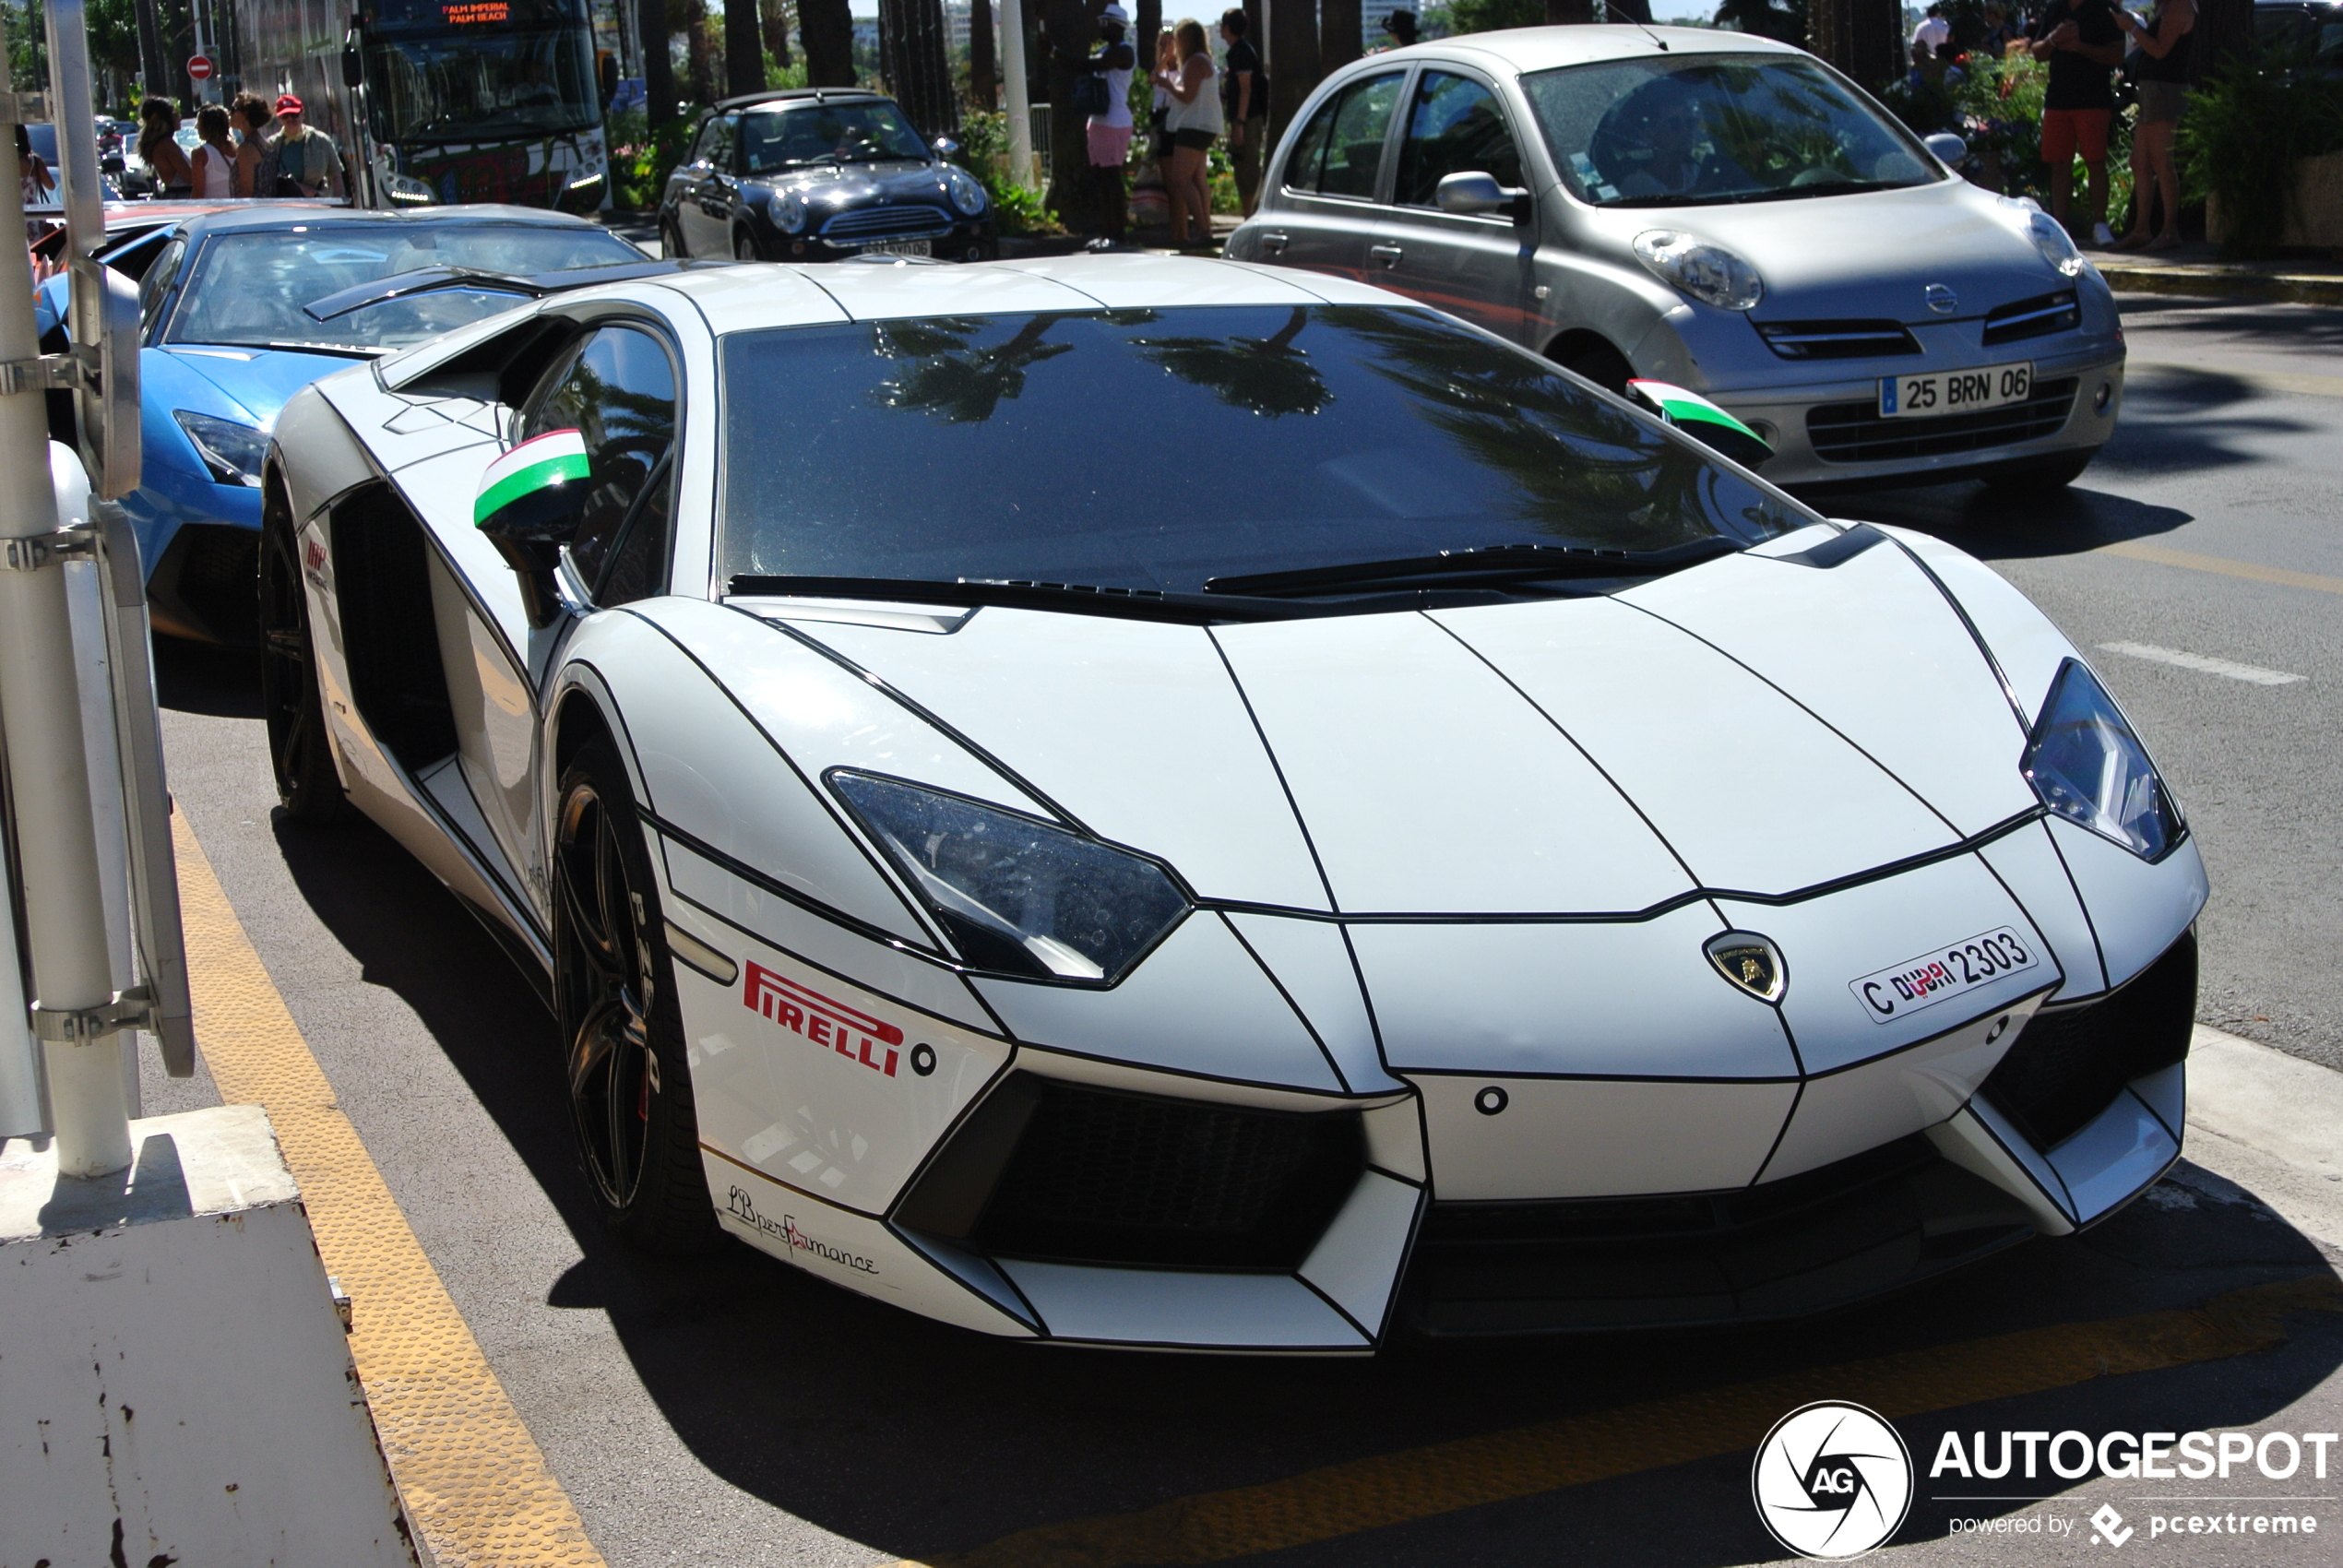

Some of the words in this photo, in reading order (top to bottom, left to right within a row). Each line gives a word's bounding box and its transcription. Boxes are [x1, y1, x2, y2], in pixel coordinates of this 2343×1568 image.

[442, 5, 469, 15] PALM
[470, 2, 510, 13] IMPERIAL
[449, 14, 475, 24] PALM
[477, 11, 507, 22] BEACH
[1906, 379, 1937, 410] 25
[1948, 374, 1991, 405] BRN
[2001, 368, 2028, 398] 06
[1862, 981, 1895, 1015] C
[1889, 960, 1957, 1002] DUBAI
[1947, 932, 2028, 985] 2303
[743, 958, 905, 1079] PIRELLI
